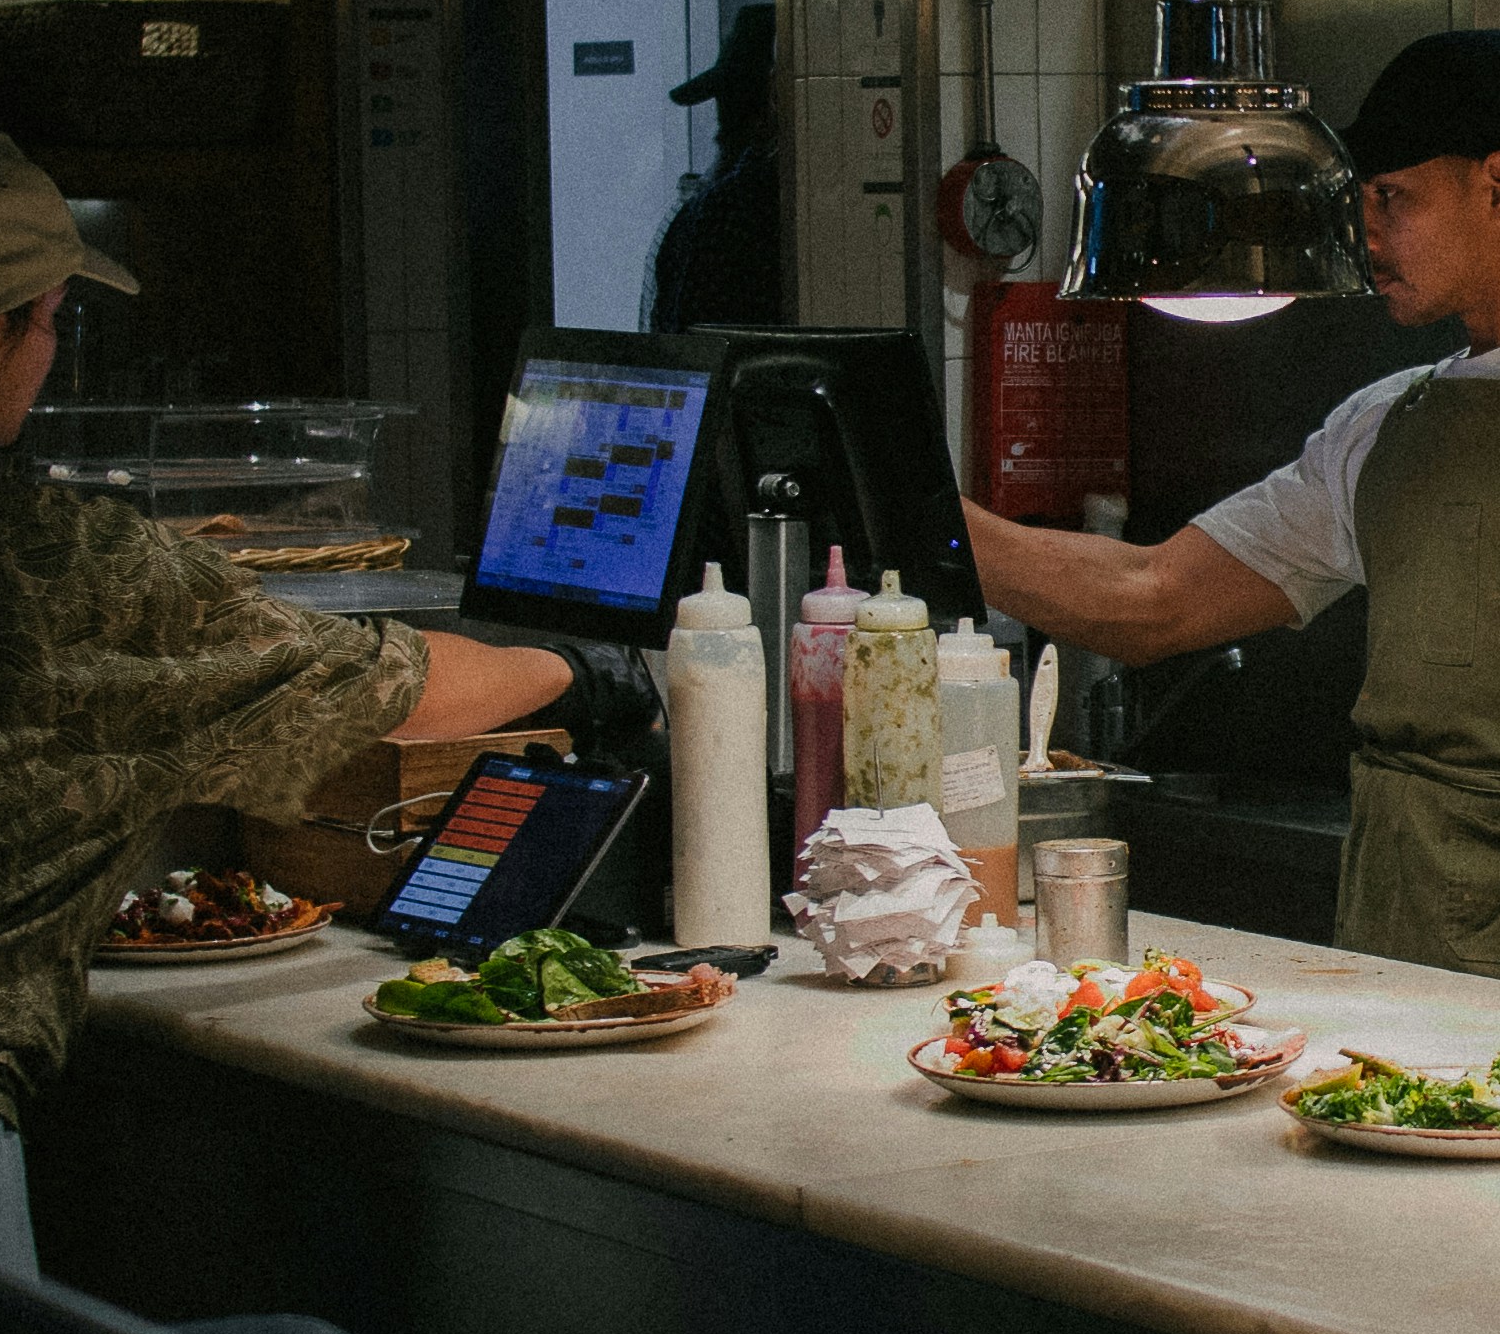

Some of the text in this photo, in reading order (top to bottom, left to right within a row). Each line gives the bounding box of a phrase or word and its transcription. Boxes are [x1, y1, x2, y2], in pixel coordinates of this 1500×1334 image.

[1004, 321, 1052, 343] MANTA
[1004, 344, 1123, 364] FIRE BLANKET
